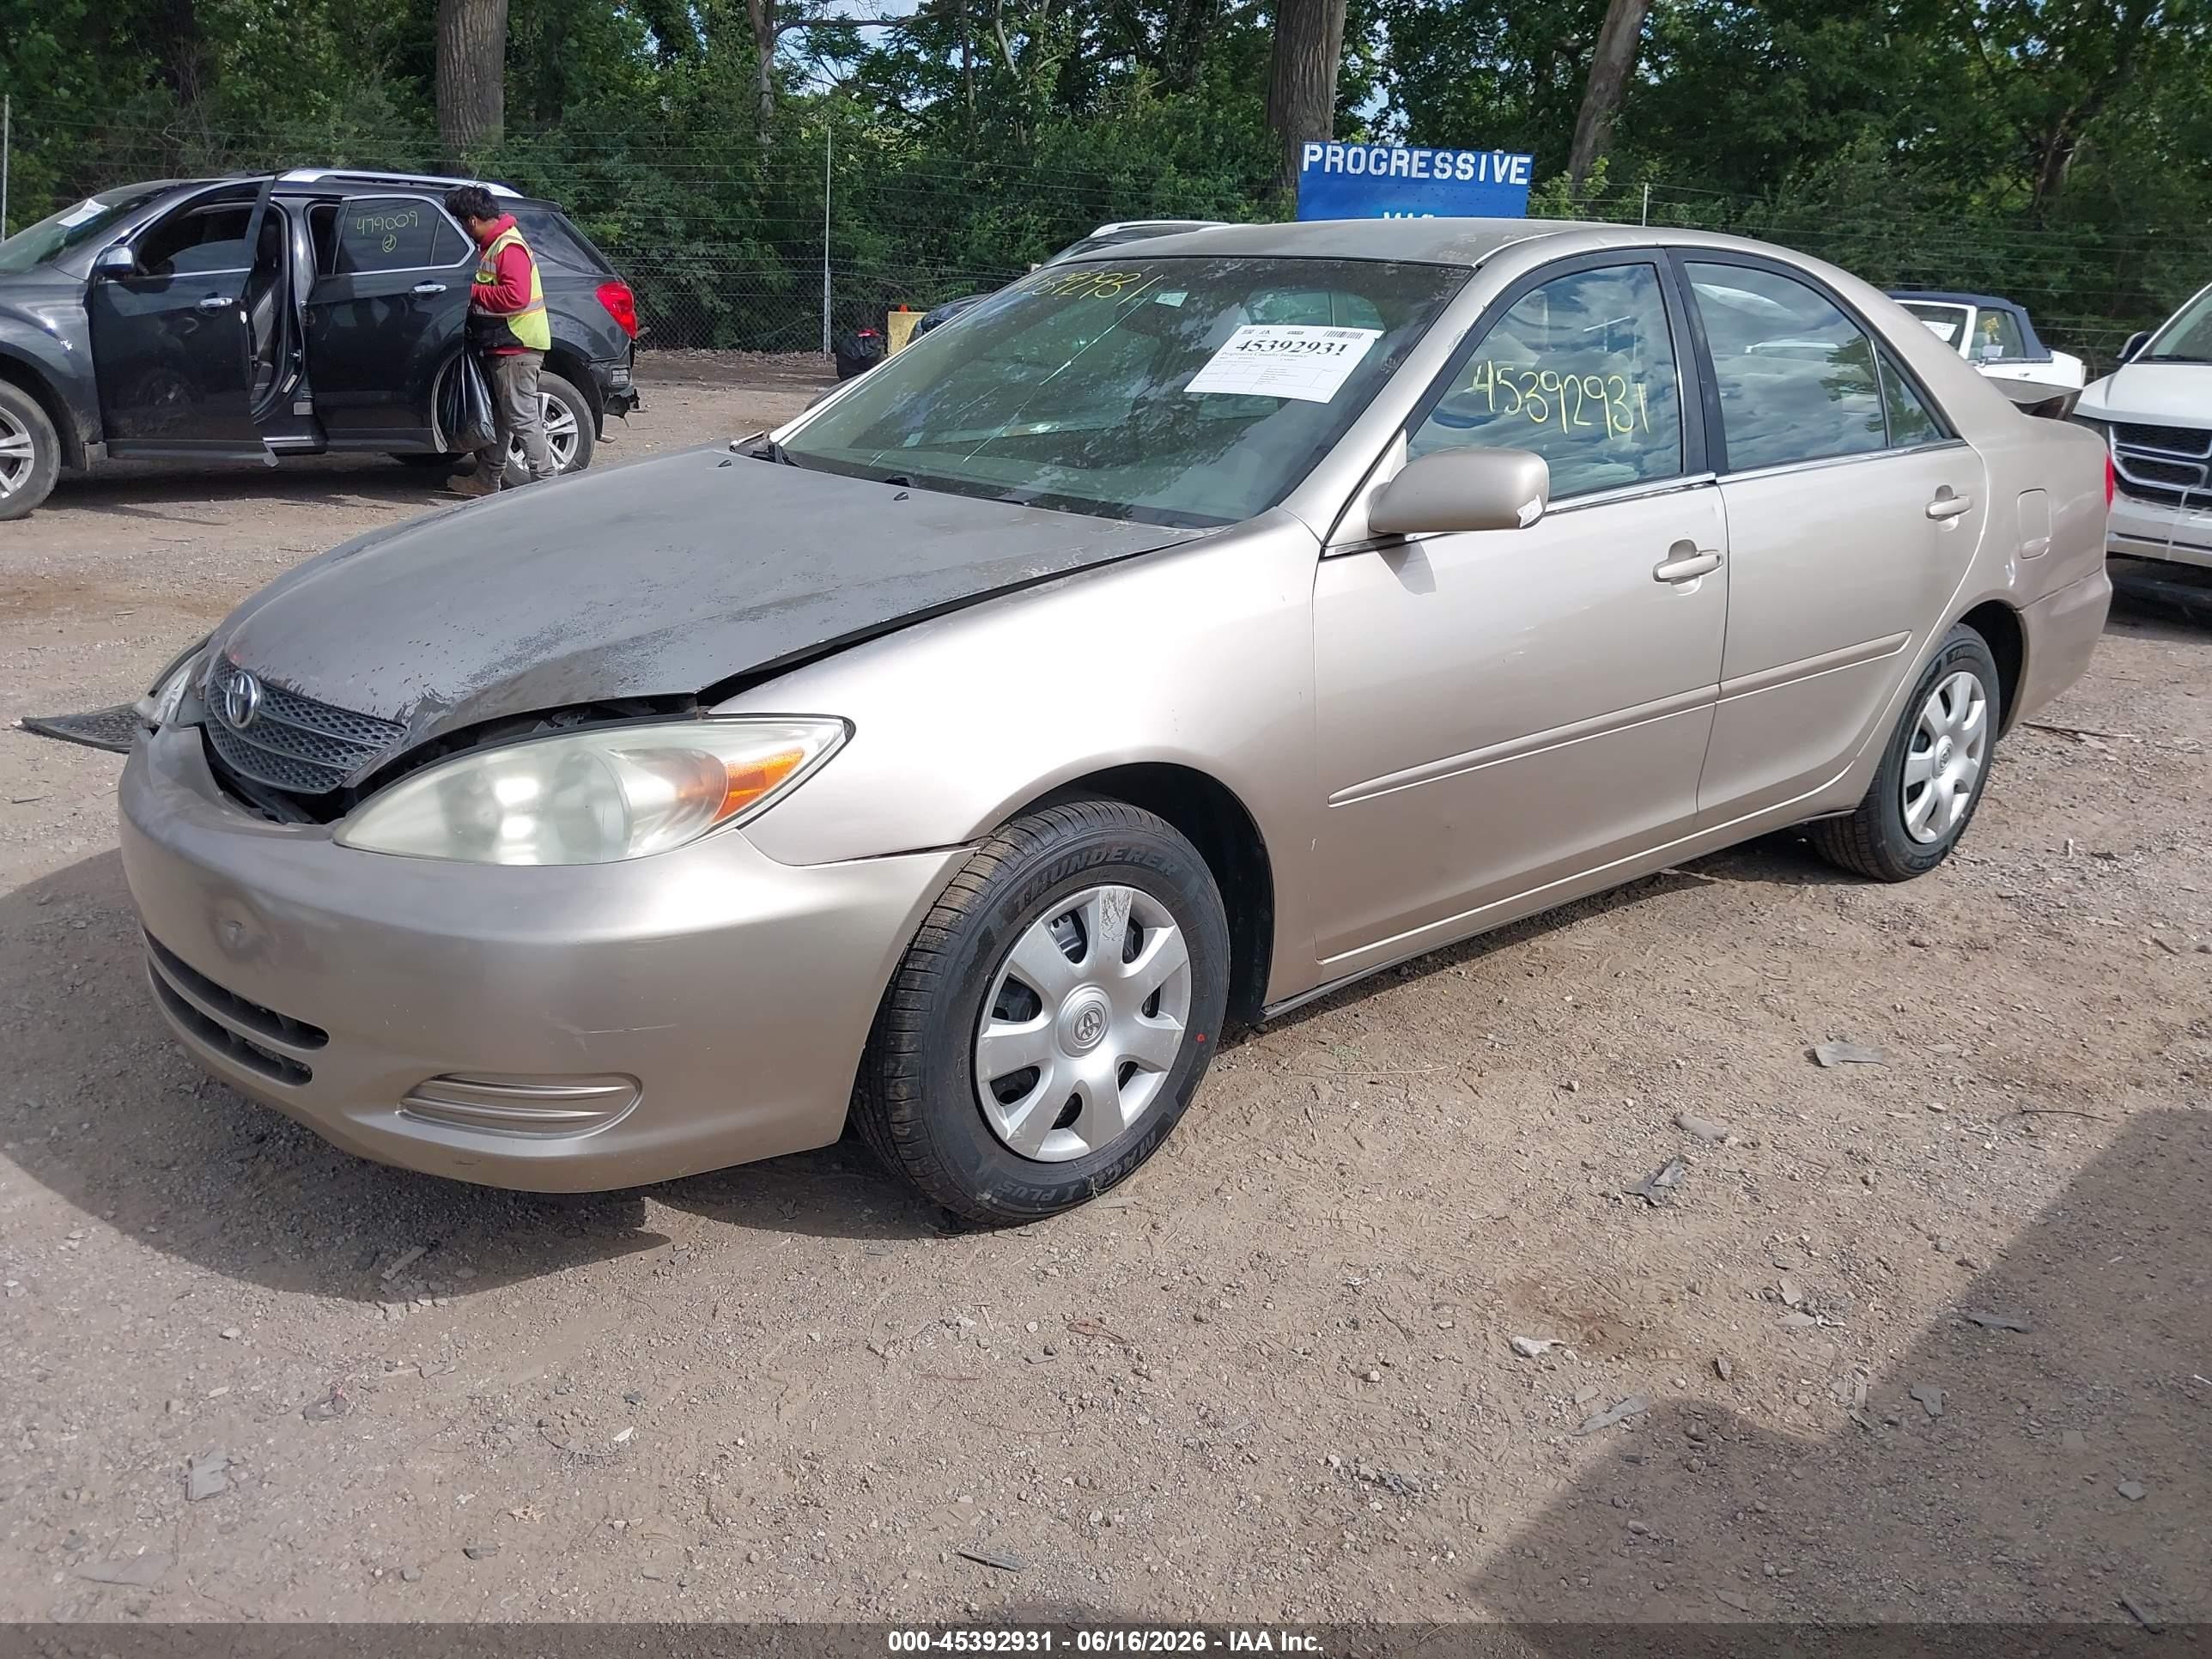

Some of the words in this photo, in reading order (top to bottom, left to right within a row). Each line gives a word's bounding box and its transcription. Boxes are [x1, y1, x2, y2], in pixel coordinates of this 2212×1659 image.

[1303, 143, 1531, 185] PROGRESSIVE
[356, 210, 418, 235] 479009
[1236, 339, 1349, 356] 45392931
[1462, 360, 1650, 441] 45392931
